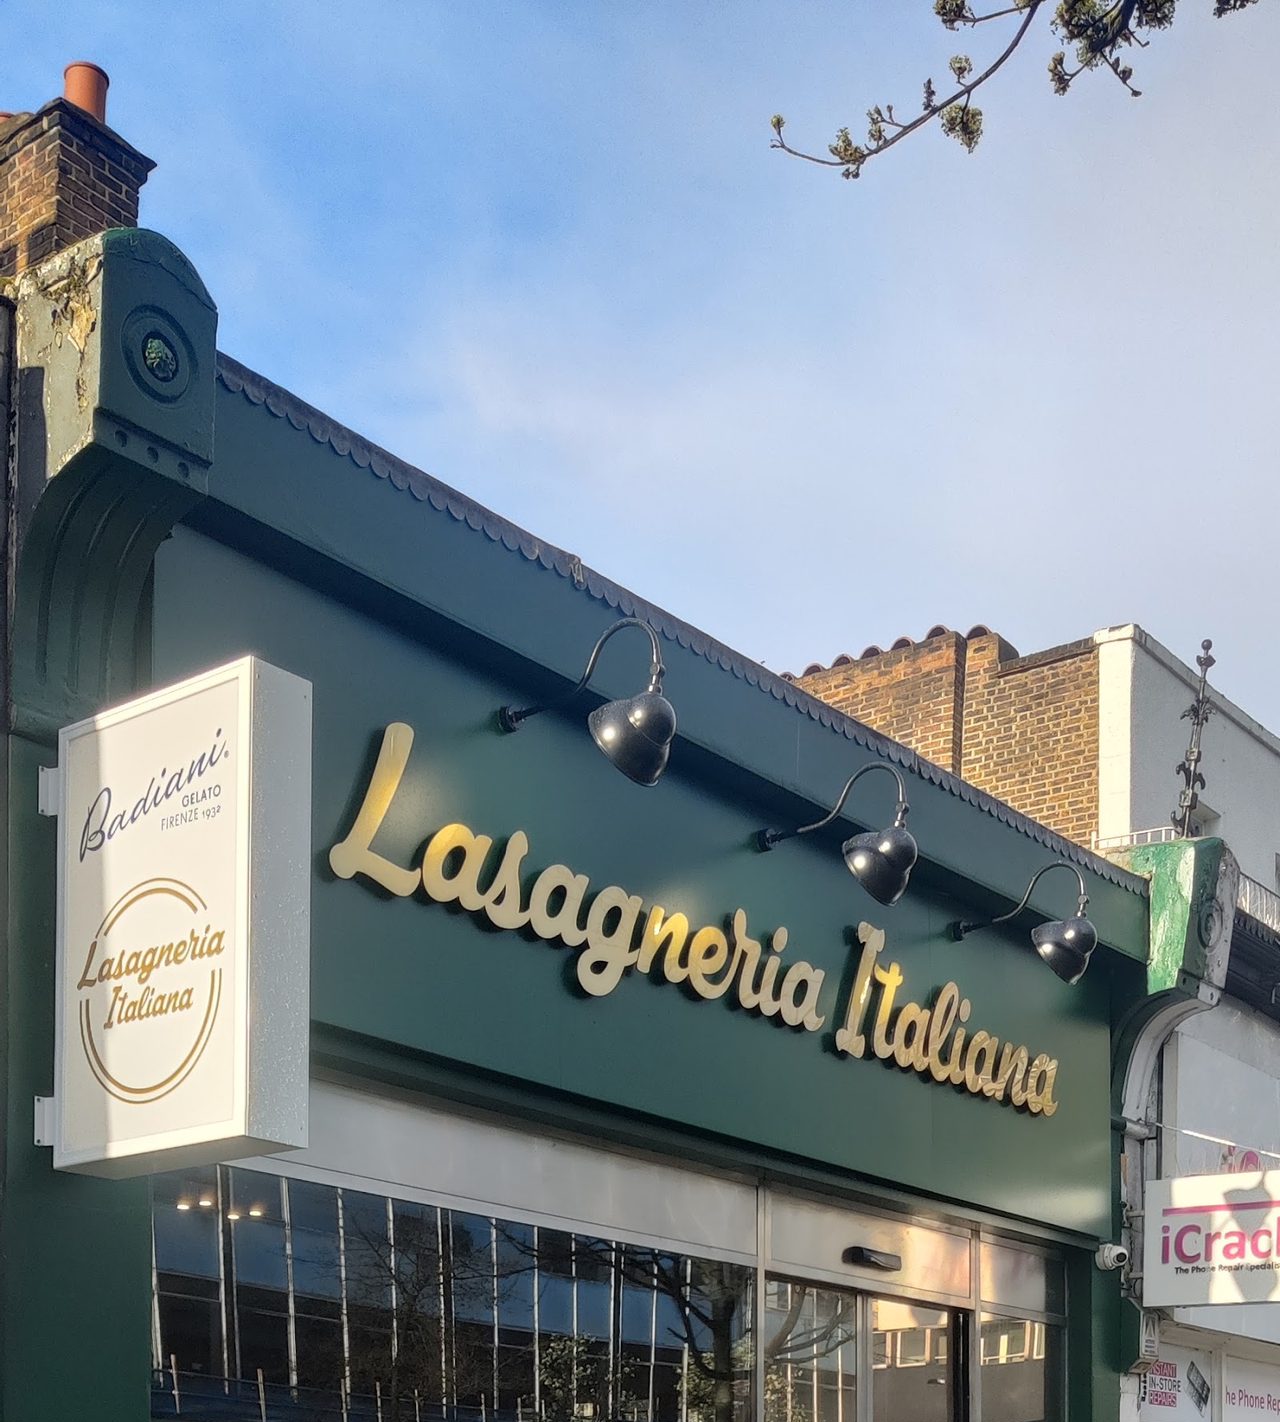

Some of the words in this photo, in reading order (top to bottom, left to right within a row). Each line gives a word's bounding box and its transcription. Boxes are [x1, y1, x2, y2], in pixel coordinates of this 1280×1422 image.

[80, 728, 228, 863] Badiani
[182, 784, 221, 807] GELATO
[161, 808, 199, 831] FIRENZE
[202, 805, 221, 821] 1932
[329, 722, 825, 1032] Lasagneria
[835, 921, 1059, 1117] Italiana
[77, 924, 226, 990] Lasagneria
[103, 985, 194, 1030] Italiana
[1174, 1266, 1189, 1275] The
[1150, 1361, 1177, 1378] NSTANT
[1149, 1376, 1181, 1393] IN-STORE
[1149, 1389, 1177, 1407] REPAIRS
[1238, 1389, 1265, 1410] Phone
